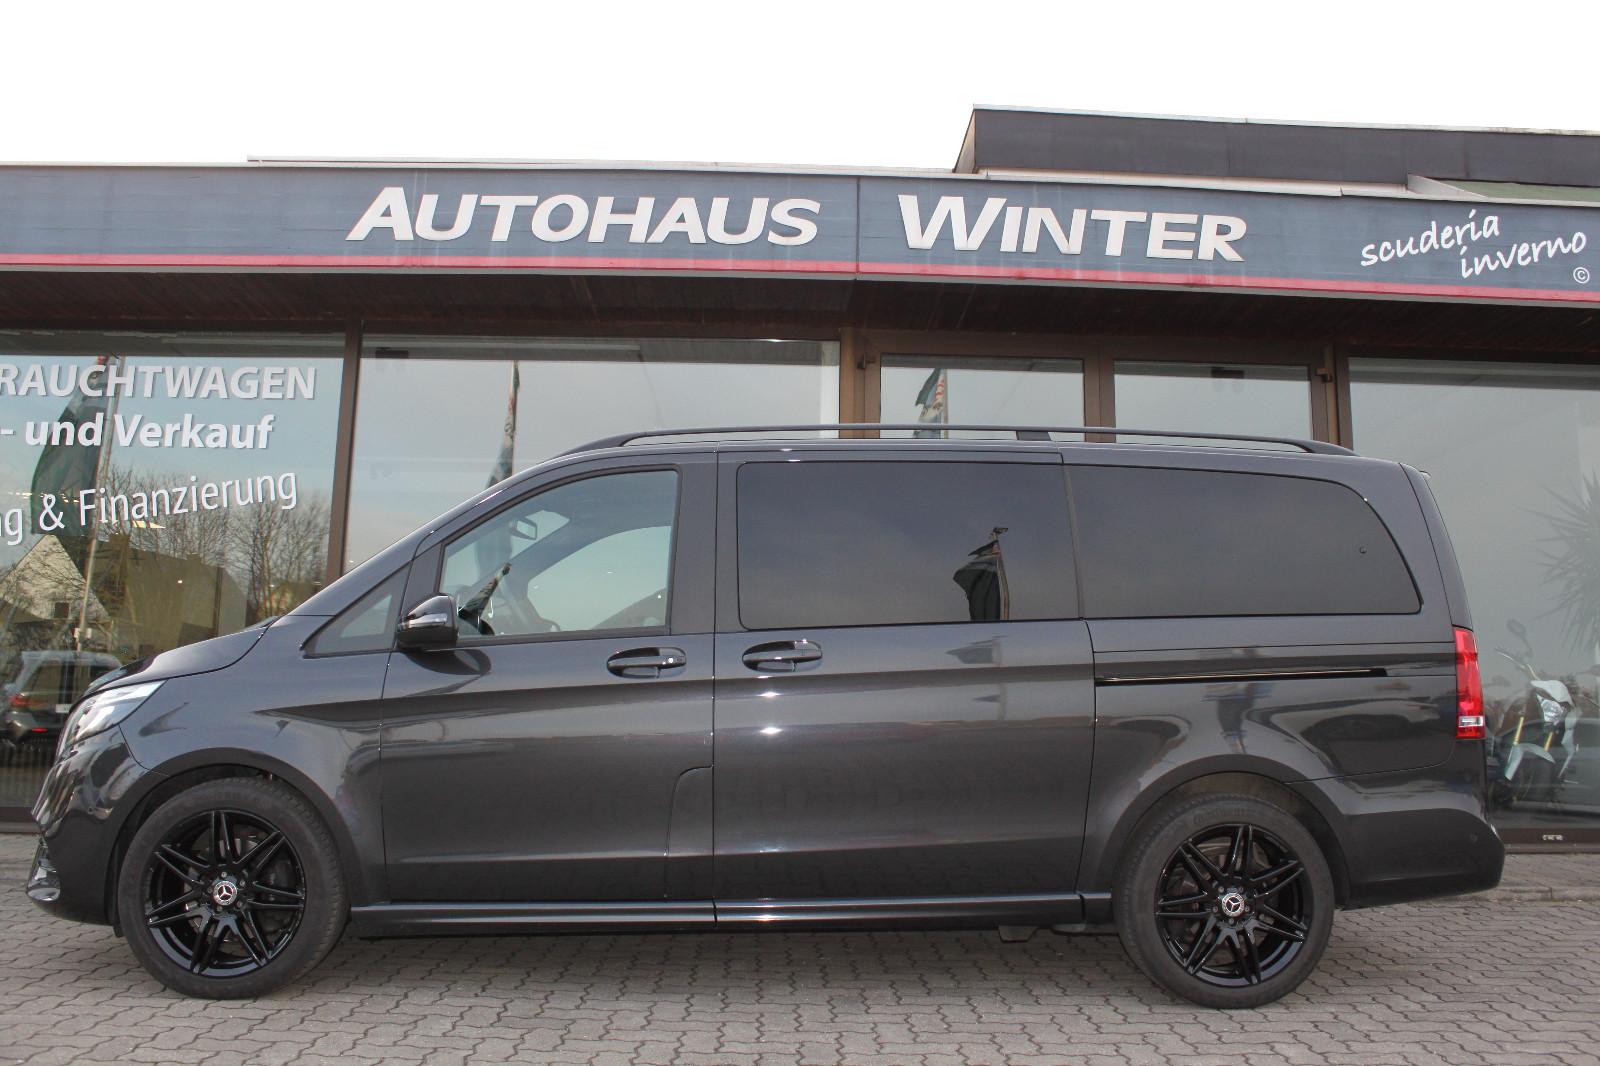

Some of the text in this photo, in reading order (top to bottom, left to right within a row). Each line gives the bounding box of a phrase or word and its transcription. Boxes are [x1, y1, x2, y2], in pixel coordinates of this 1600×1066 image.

[345, 186, 1247, 262] AUTOHAUS WINTER
[1360, 208, 1500, 267] scuderia
[1459, 231, 1588, 279] inverno
[25, 412, 104, 446] und
[114, 413, 274, 449] Verkauf
[39, 493, 65, 531] &
[79, 472, 297, 526] Finanzierung
